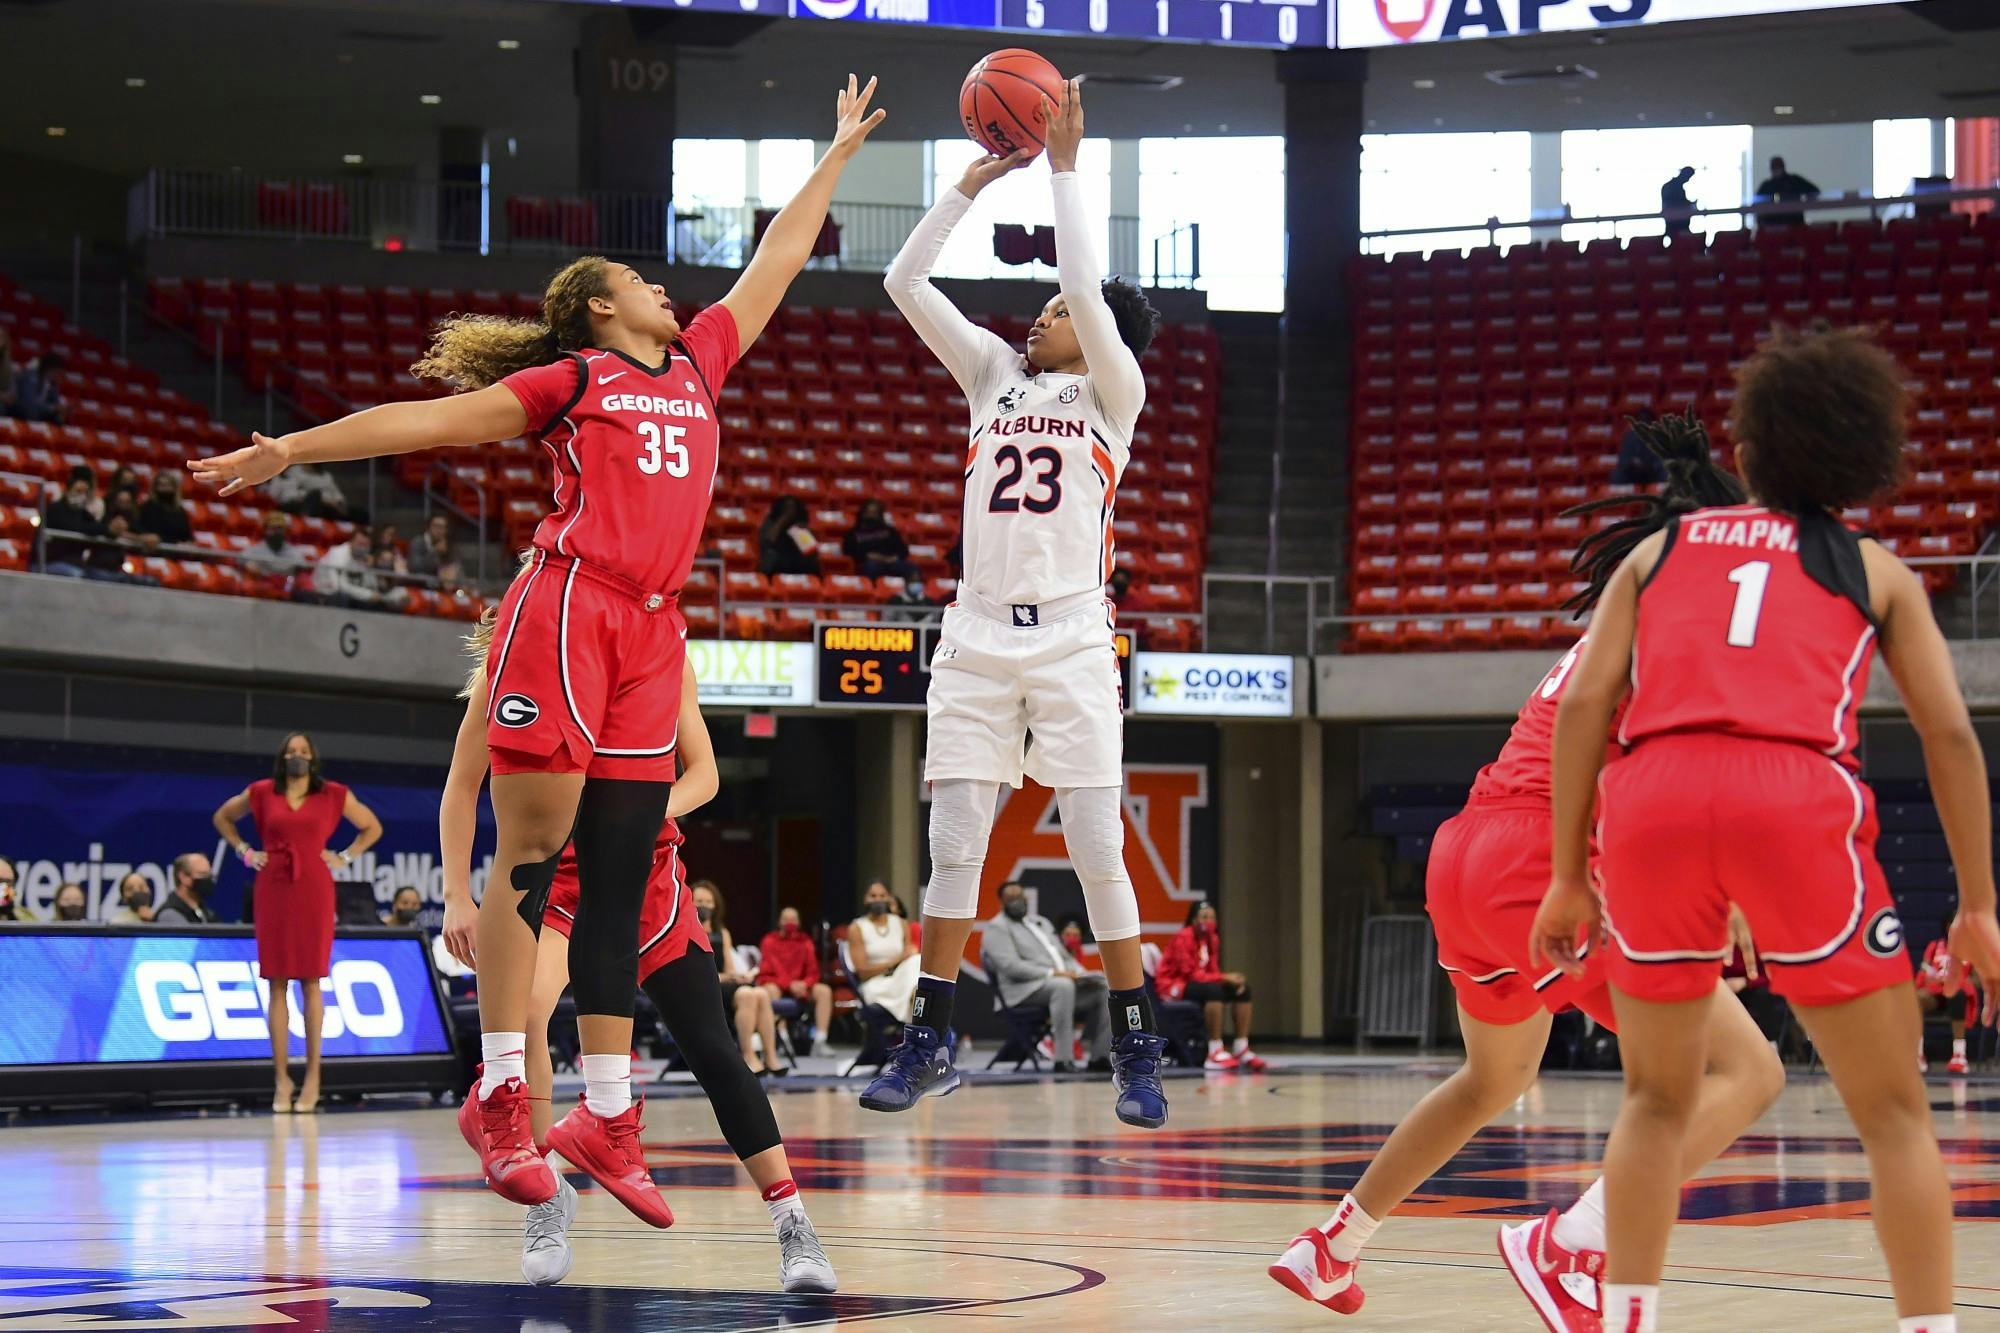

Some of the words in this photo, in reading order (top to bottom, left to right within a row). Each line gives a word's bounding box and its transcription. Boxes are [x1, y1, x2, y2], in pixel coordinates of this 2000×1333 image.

[1156, 0, 1169, 37] 1
[1219, 2, 1233, 40] 1
[1278, 5, 1299, 45] 0
[609, 58, 670, 92] 109
[601, 393, 709, 421] GEORGIA
[987, 415, 1086, 438] AUBURN
[637, 420, 690, 478] 35
[988, 444, 1063, 514] 23
[1687, 518, 1799, 553] CHAPM
[1727, 560, 1771, 648] 1
[339, 622, 361, 659] G
[824, 627, 914, 651] AUBURN
[688, 641, 793, 682] DIXIE
[839, 658, 883, 695] 25
[1185, 668, 1287, 689] COOK'S
